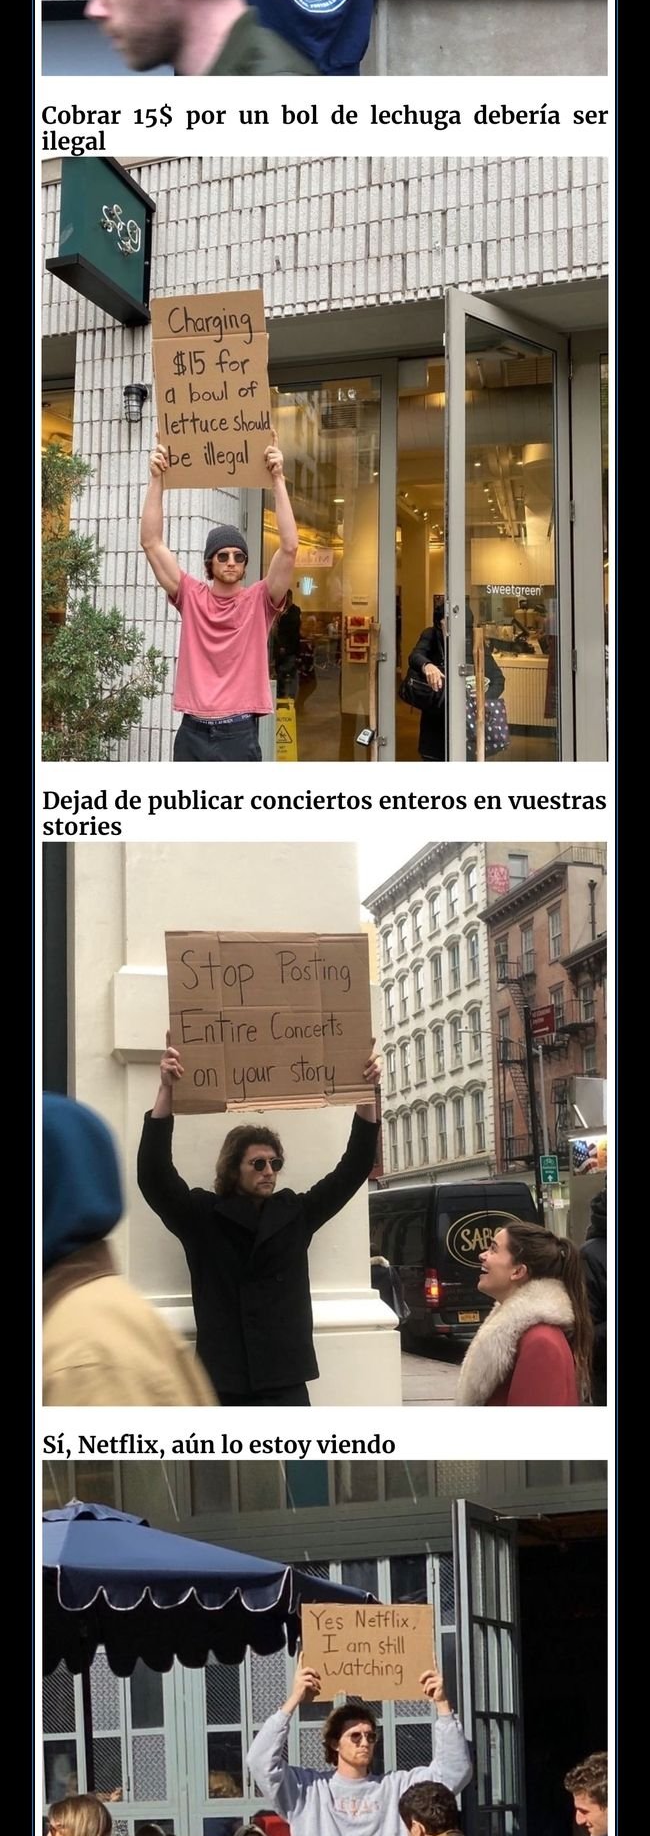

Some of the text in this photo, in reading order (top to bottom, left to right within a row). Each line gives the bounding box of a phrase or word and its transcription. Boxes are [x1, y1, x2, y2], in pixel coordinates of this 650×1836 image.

[167, 306, 254, 345] Charging
[173, 349, 250, 376] $15 for
[189, 381, 229, 403] bowl
[238, 380, 259, 398] of
[164, 413, 229, 435] lettuce
[167, 440, 250, 475] be illegal
[486, 584, 542, 597] sweetgreen
[181, 950, 352, 1005] Stop Posting
[180, 1008, 344, 1044] Entire Concerts
[193, 1067, 218, 1087] on
[233, 1064, 276, 1103] your
[309, 1609, 344, 1631] Yes
[322, 1633, 406, 1655] I am still
